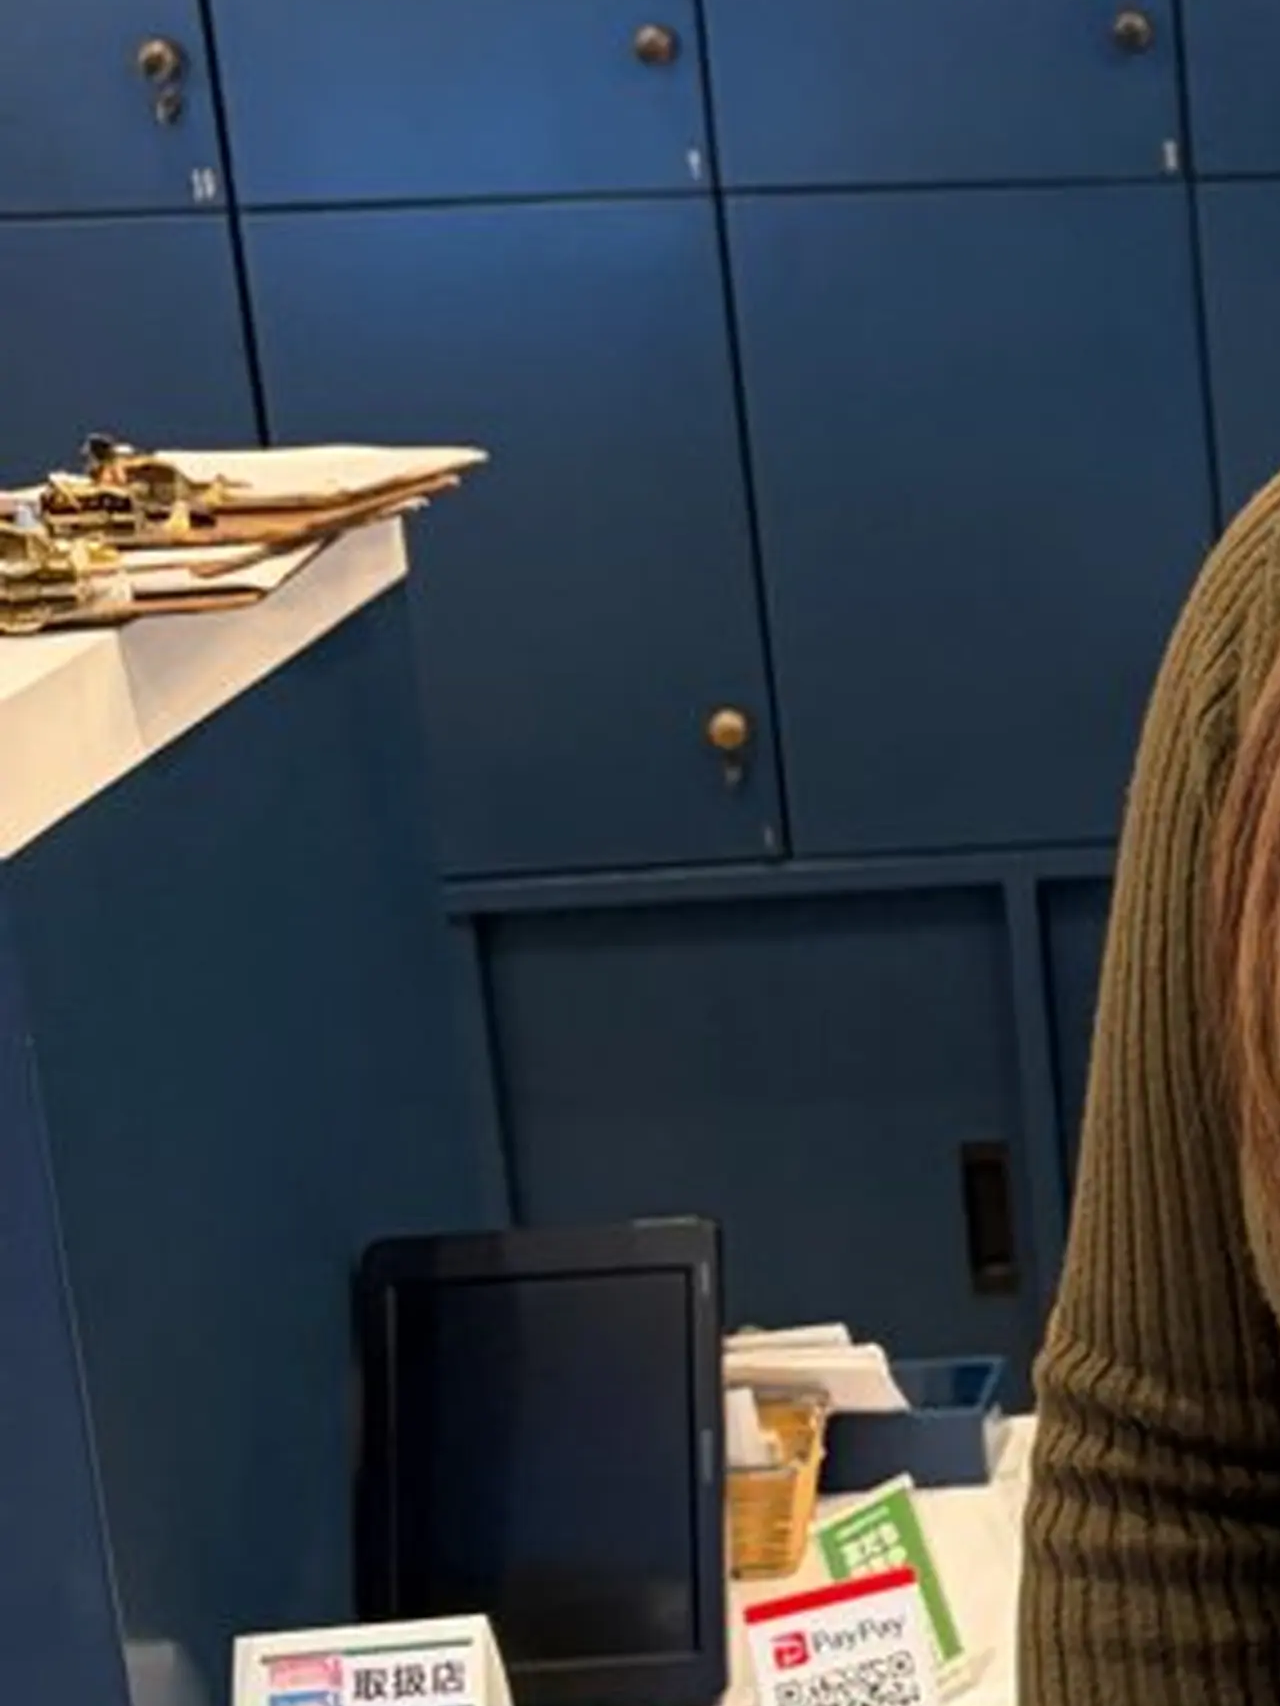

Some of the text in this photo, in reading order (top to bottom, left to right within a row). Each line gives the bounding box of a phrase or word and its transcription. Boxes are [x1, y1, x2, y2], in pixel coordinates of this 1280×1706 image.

[811, 1618, 905, 1653] PayPay
[352, 1660, 466, 1701] 取扱店
